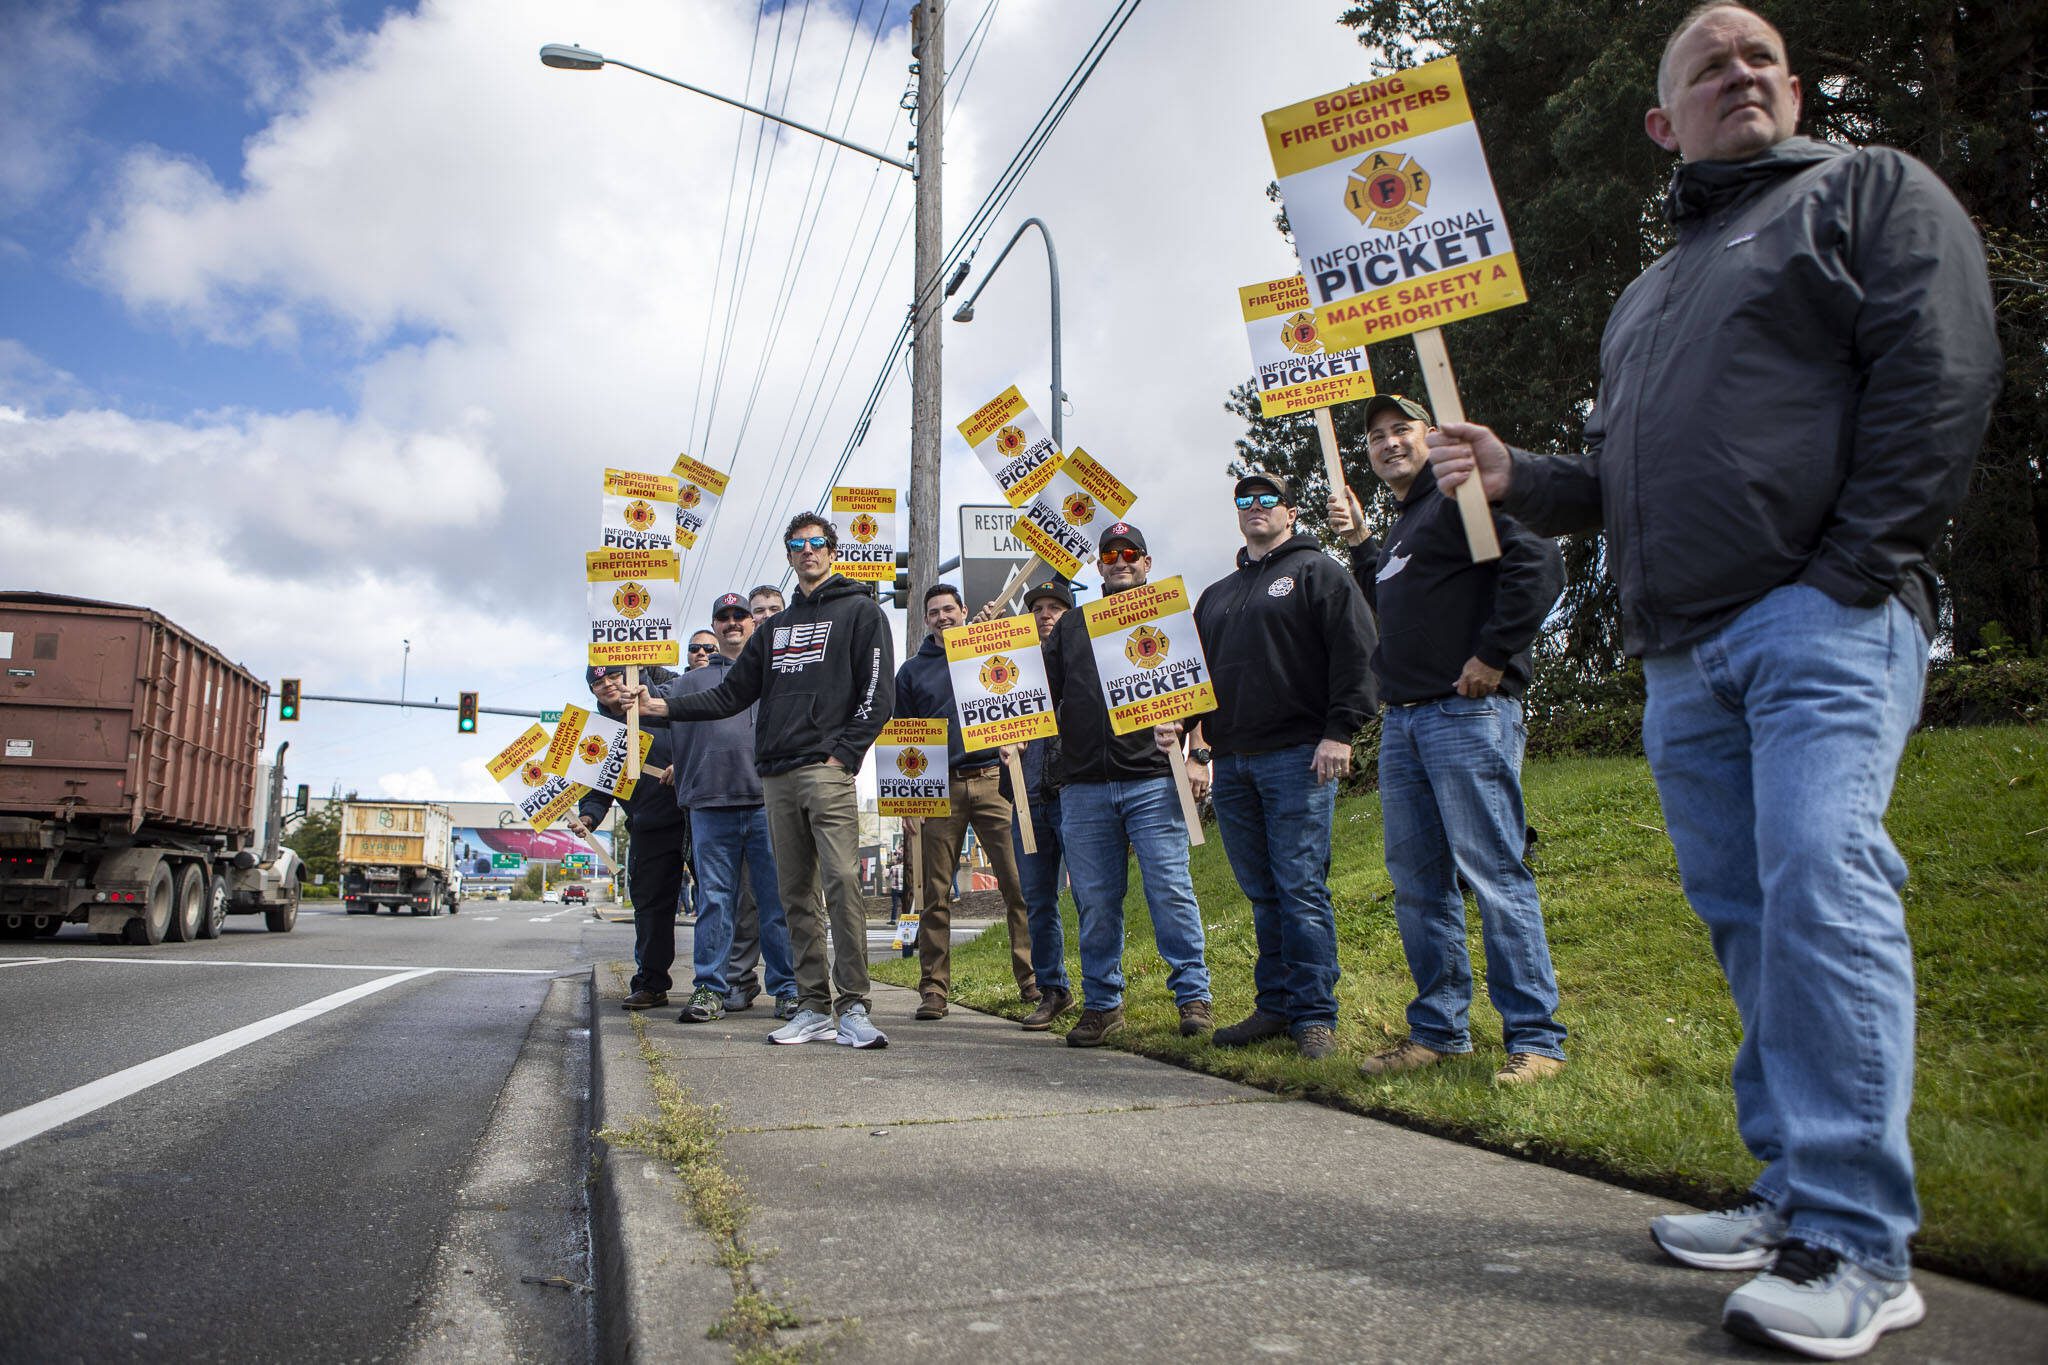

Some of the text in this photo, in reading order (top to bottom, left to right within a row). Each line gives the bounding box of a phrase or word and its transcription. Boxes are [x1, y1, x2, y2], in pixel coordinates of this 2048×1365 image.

[1314, 77, 1405, 116] BOEING
[1280, 85, 1451, 147] FIREFIGHTERS
[1332, 118, 1409, 152] UNION
[1373, 154, 1388, 170] A
[1350, 172, 1422, 209] I F F
[1311, 209, 1493, 274] INFORMATIONAL
[1317, 223, 1495, 303] PICKET
[1268, 277, 1305, 291] BOEIN
[1328, 265, 1507, 325] MAKE SAFETY A
[1248, 286, 1308, 306] FIREFIGH
[1276, 298, 1309, 311] UNIO
[1365, 292, 1478, 335] PRIORITY!
[1261, 355, 1361, 390] PICKET
[1266, 376, 1365, 402] MAKE SAFETY A
[1287, 389, 1349, 408] PRIORITY!
[967, 396, 1019, 437] FIREFIGHTERS
[974, 398, 1003, 421] BOEING
[985, 412, 1010, 433] UNION
[692, 461, 716, 476] BOEING
[995, 437, 1051, 480] INFORMATIONAL
[1000, 442, 1055, 490] PICKET
[609, 478, 673, 492] FIREFIGHTERS
[625, 472, 658, 483] BOEING
[679, 461, 723, 487] FIREFIGHTERS
[688, 473, 707, 487] UNION
[1009, 480, 1030, 498] MAKE
[1030, 460, 1055, 482] SAFETY
[1023, 469, 1057, 497] PRIORITY!
[1072, 459, 1127, 507] FIREFIGHTERS
[1090, 462, 1120, 490] BOEING
[627, 489, 655, 497] UNION
[1082, 477, 1108, 501] UNION
[676, 513, 702, 532] KET
[677, 507, 703, 524] ATIONAL
[975, 515, 1016, 530] RESTRI
[1035, 500, 1092, 552] INFORMATIONAL
[605, 528, 670, 541] INFORMATIONAL
[605, 534, 671, 549] PICKET
[1021, 519, 1043, 536] MAKE
[1043, 537, 1071, 564] SAFETY
[1028, 507, 1089, 559] PICKET
[610, 552, 650, 560] BOEING
[835, 550, 893, 562] PICKET
[1026, 535, 1063, 567] PRIORITY!
[592, 560, 668, 569] FIREFIGHTERS
[614, 570, 647, 578] UNION
[1092, 590, 1179, 622] FIREFIGHTERS
[1109, 586, 1156, 606] BOEING
[592, 618, 672, 628] INFORMATIONAL
[967, 620, 1010, 635] BOEING
[1118, 607, 1158, 626] UNION
[592, 626, 671, 642] PICKET
[951, 626, 1031, 648] FIREFIGHTERS
[608, 653, 657, 662] PRIORITY!
[975, 640, 1011, 654] UNION
[1106, 657, 1201, 690] INFORMATIONAL
[1109, 666, 1201, 707] PICKET
[961, 688, 1046, 711] INFORMATIONAL
[1115, 688, 1208, 720] MAKE SAFETY A
[544, 712, 562, 721] KAS
[962, 696, 1046, 727] PICKET
[1135, 703, 1193, 725] PRIORITY!
[550, 722, 566, 753] BOEING
[968, 725, 997, 737] MAKE
[999, 717, 1039, 731] SAFETY
[984, 728, 1037, 744] PRIORITY!
[500, 736, 527, 759] BOEING
[552, 711, 579, 769] FIREFIGHTERS
[565, 729, 580, 756] UNION
[493, 732, 542, 773] FIREFIGHTERS
[511, 748, 534, 768] UNION
[596, 728, 625, 787] INFORMATIONAL
[519, 776, 561, 809] INFORMATIO
[524, 778, 569, 817] PICKE
[880, 786, 945, 797] PICKET
[533, 806, 552, 824] MAKE
[552, 786, 577, 807] SAFETY
[545, 794, 578, 821] PRIORITY!
